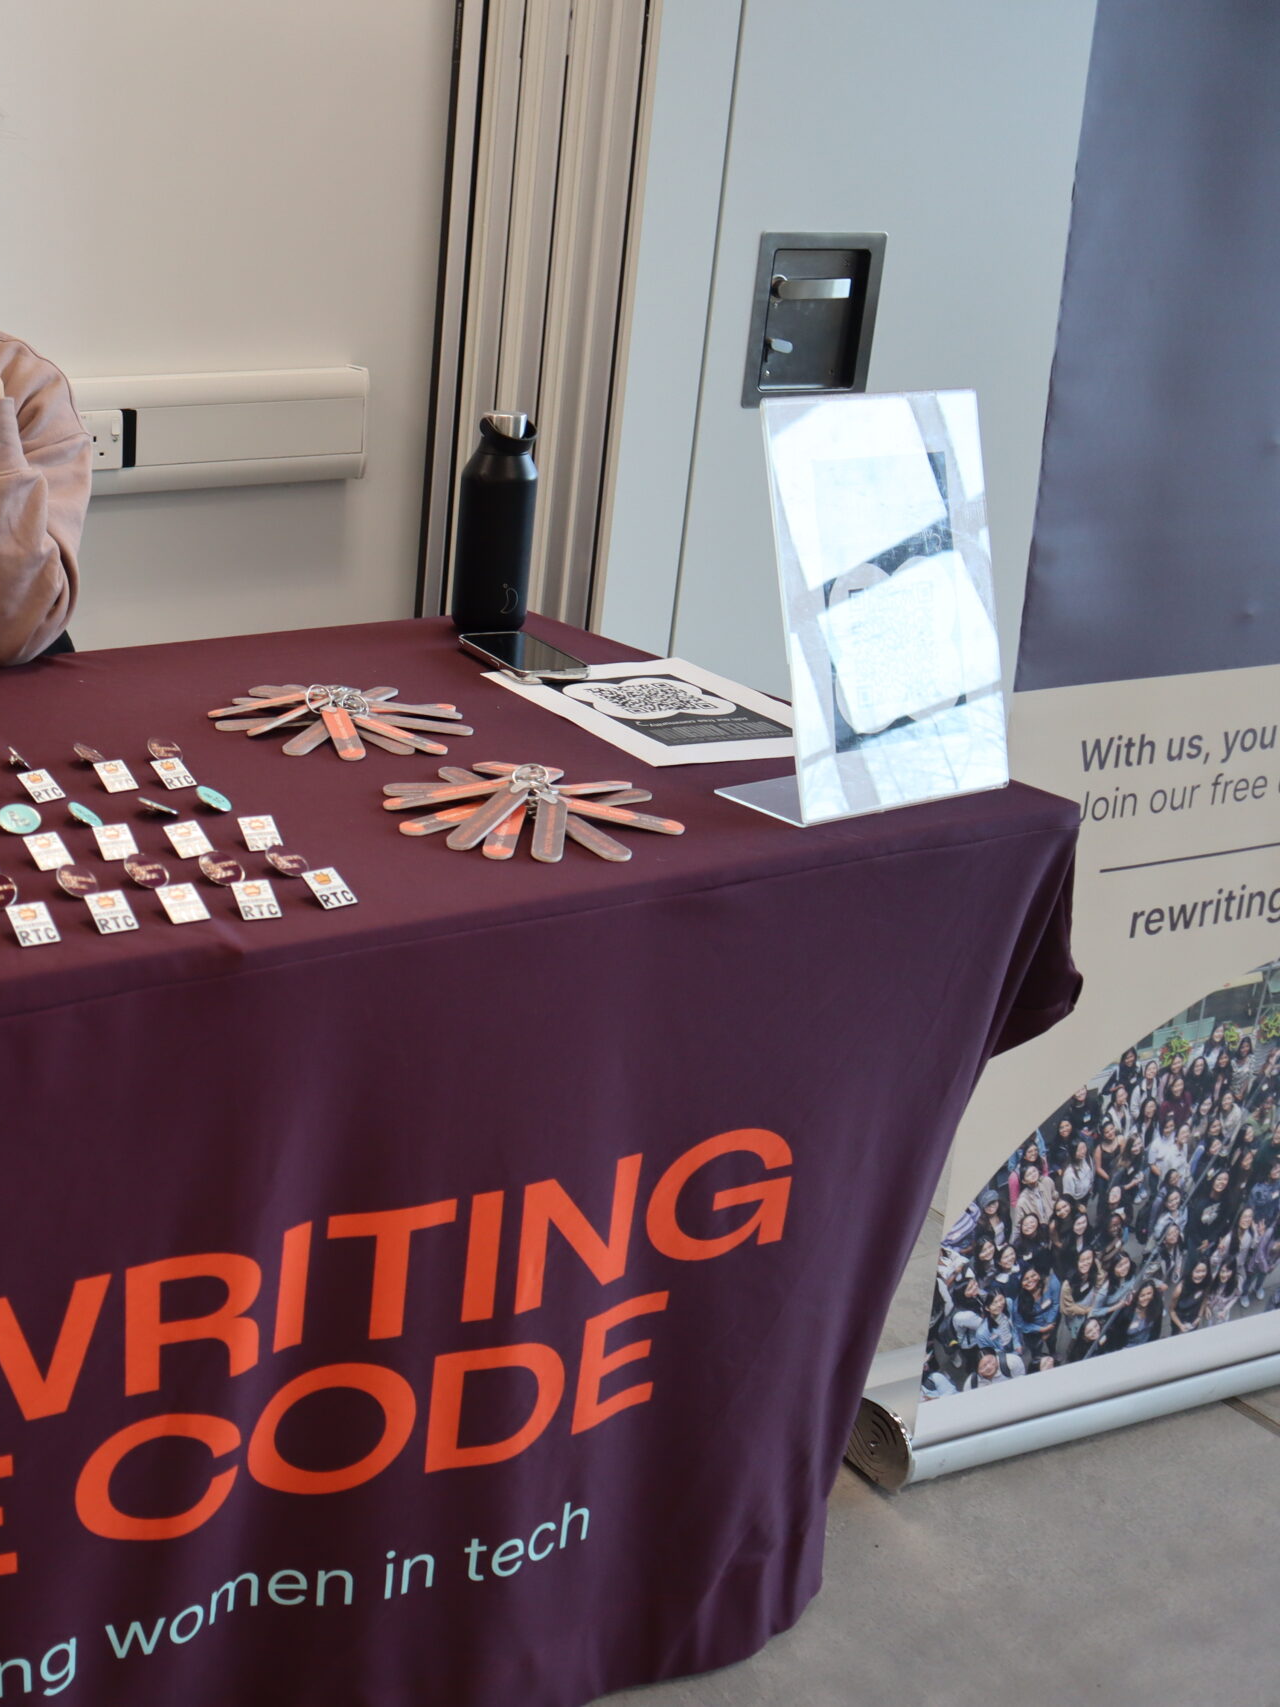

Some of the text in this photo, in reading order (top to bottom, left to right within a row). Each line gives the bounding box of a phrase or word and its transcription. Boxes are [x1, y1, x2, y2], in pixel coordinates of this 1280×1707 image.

[1081, 725, 1277, 772] With us, you
[165, 775, 194, 788] RTC
[33, 786, 64, 801] RTC
[1080, 773, 1268, 822] Join our free
[320, 890, 354, 907] RTC
[241, 903, 279, 918] RTC
[1129, 884, 1280, 939] rewriting
[97, 915, 135, 932] RTC
[19, 927, 57, 944] RTC
[74, 1291, 669, 1541] CODE
[105, 1569, 355, 1659] women
[384, 1550, 435, 1600] in
[464, 1502, 591, 1582] tech
